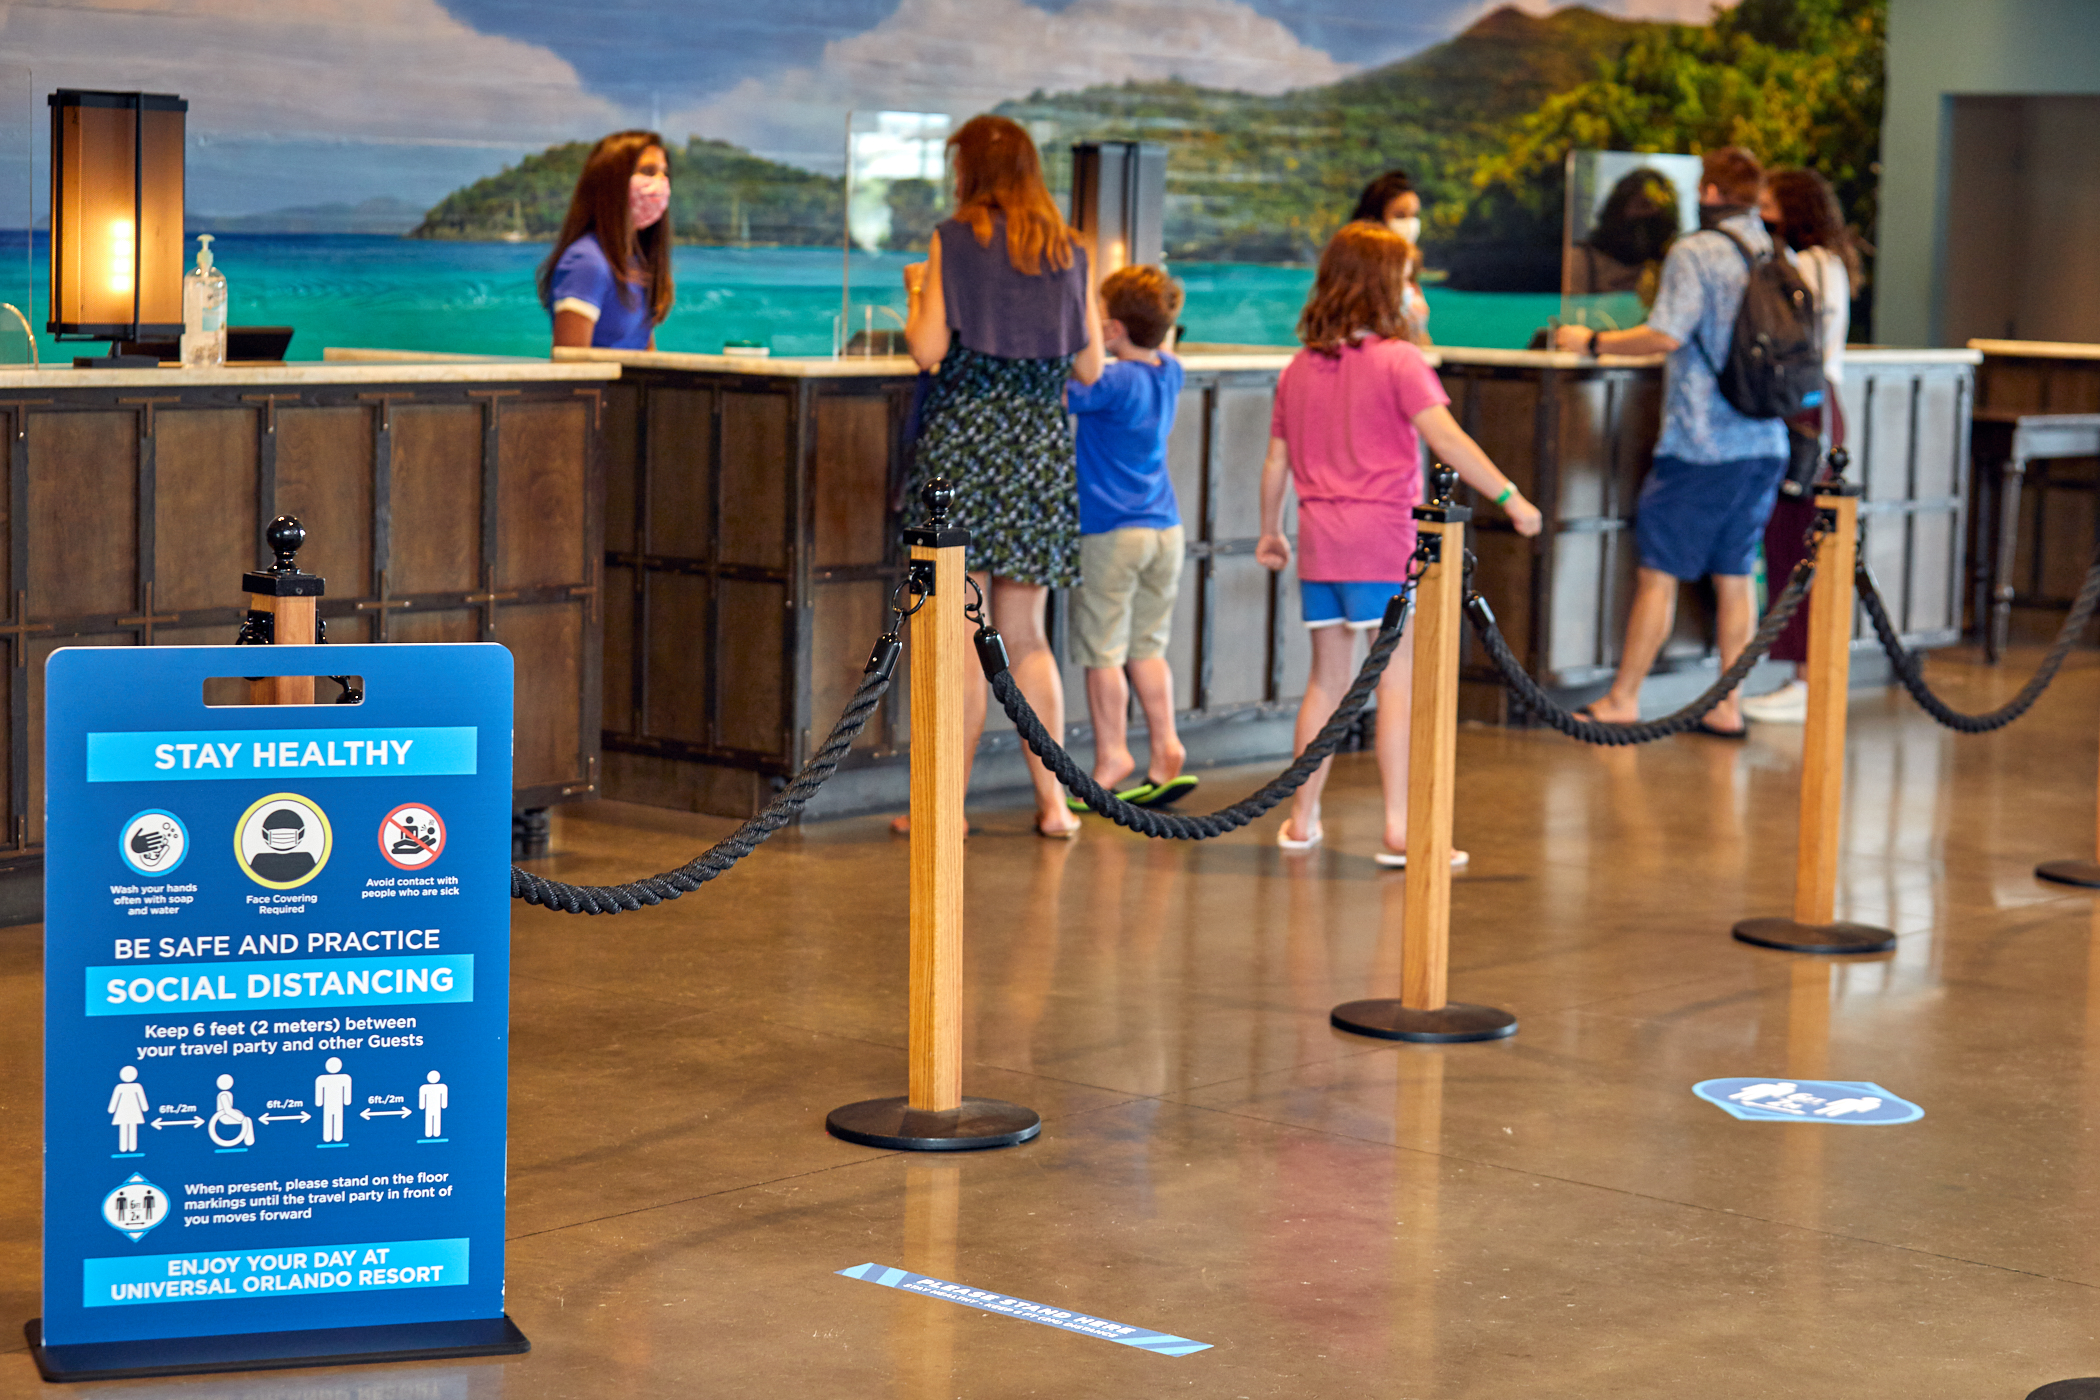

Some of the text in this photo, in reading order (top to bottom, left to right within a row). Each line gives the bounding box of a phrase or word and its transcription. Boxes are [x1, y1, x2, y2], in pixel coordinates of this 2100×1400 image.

[155, 740, 413, 769] STAY HEALTHY
[110, 884, 198, 895] Wash your hands
[366, 876, 458, 886] Avoid contact with
[114, 895, 194, 905] often with soap
[273, 894, 317, 903] Covering
[362, 889, 396, 899] people
[399, 888, 420, 896] who
[440, 887, 459, 895] sick
[128, 907, 148, 915] and
[259, 905, 304, 915] Required
[115, 929, 440, 959] BE SAFE AND PRACTICE
[107, 968, 453, 1003] SOCIAL DISTANCING
[145, 1017, 416, 1039] Keep 6 feet (2 meters) between
[137, 1034, 423, 1060] your travel party and other Guests
[185, 1172, 449, 1195] When present, please stand on the floor
[185, 1185, 452, 1209] markings until the travel party in front of
[185, 1208, 311, 1227] you moves forward
[168, 1248, 390, 1276] ENJOY YOUR DAY AT
[111, 1266, 443, 1300] UNIVERSAL ORLANDO RESORT
